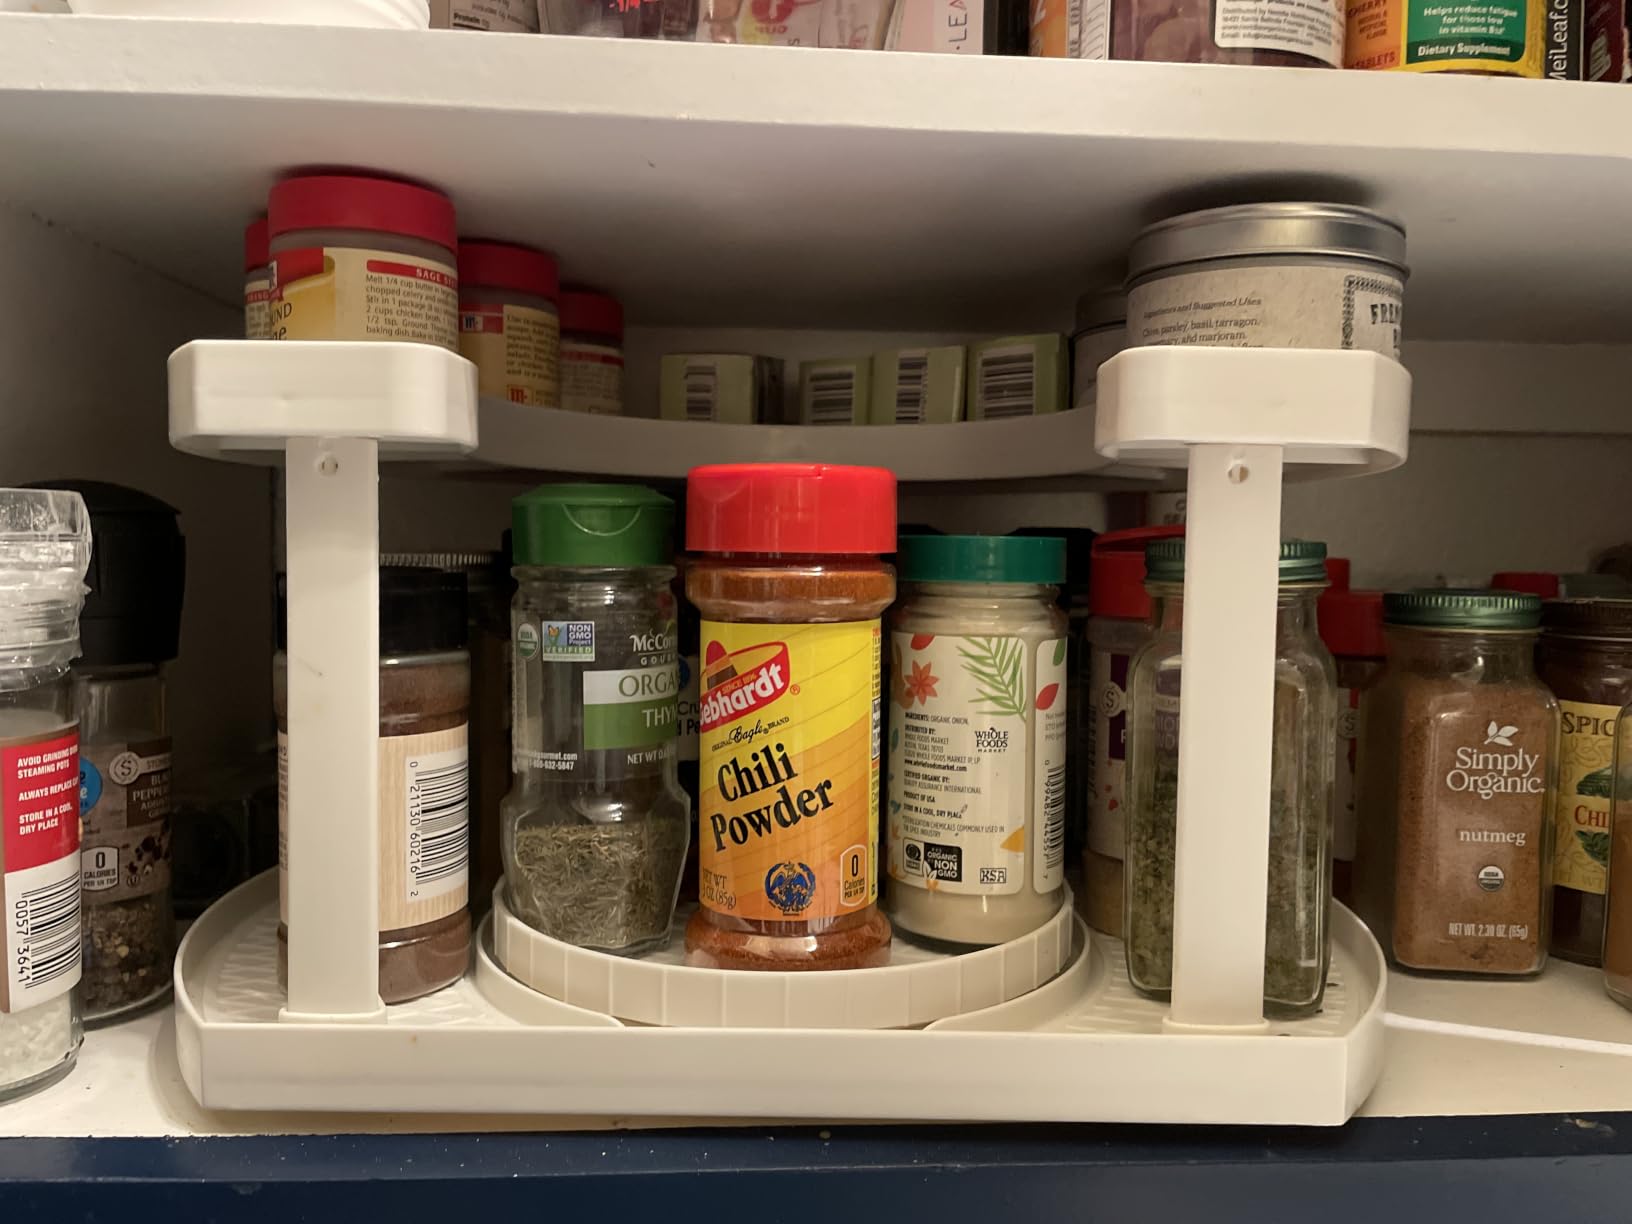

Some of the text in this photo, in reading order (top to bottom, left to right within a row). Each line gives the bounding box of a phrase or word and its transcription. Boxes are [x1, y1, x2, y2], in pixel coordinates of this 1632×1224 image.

[1424, 6, 1453, 17] Helps
[1454, 6, 1487, 14] reduce
[1442, 15, 1504, 24] for those low
[1439, 26, 1450, 34] in
[1451, 26, 1487, 35] vitamin
[1417, 42, 1511, 56] Dietary Supplement
[416, 268, 442, 281] SAGE
[366, 274, 383, 283] Melt
[400, 280, 414, 289] cup
[366, 285, 401, 296] chopped
[374, 307, 394, 317] cups
[366, 325, 394, 337] baking
[569, 624, 591, 633] NON
[569, 631, 592, 640] GMO
[930, 715, 950, 724] ORGANIC
[729, 719, 763, 744] Eagle
[768, 716, 790, 730] BRAND
[975, 730, 1009, 741] WHOLE
[931, 737, 950, 745] MARKET
[976, 738, 1008, 748] FOODS
[18, 756, 42, 768] AVOID
[42, 747, 70, 763] GRINDING
[408, 760, 419, 768] 0
[628, 752, 644, 766] NET
[946, 754, 967, 763] MARKET
[1455, 746, 1540, 779] Simply
[17, 759, 70, 780] STEAMING POTS
[717, 742, 799, 803] Chili
[18, 787, 49, 802] ALWAYS
[50, 781, 73, 796] REPLACE
[943, 784, 982, 795] INTERNATIONAL
[926, 795, 936, 803] USA
[409, 785, 421, 827] 21130
[19, 811, 45, 825] STORE
[45, 809, 53, 818] IN
[710, 778, 834, 853] Powder
[19, 818, 59, 836] DRY PLACE
[956, 824, 985, 833] COMMONLY
[985, 824, 999, 833] USED
[1459, 829, 1527, 846] nutmeg
[409, 832, 421, 874] 60216
[927, 851, 958, 862] ORGANIC
[95, 851, 106, 869] 0
[851, 854, 860, 878] 0
[934, 860, 958, 870] NON
[84, 868, 117, 880] CALORIES
[937, 869, 958, 879] GMO
[714, 873, 728, 889] WT
[715, 888, 737, 911] (85g)
[1448, 922, 1463, 936] NET
[1508, 924, 1529, 940] (65g)
[15, 899, 32, 984] 0057 3641
